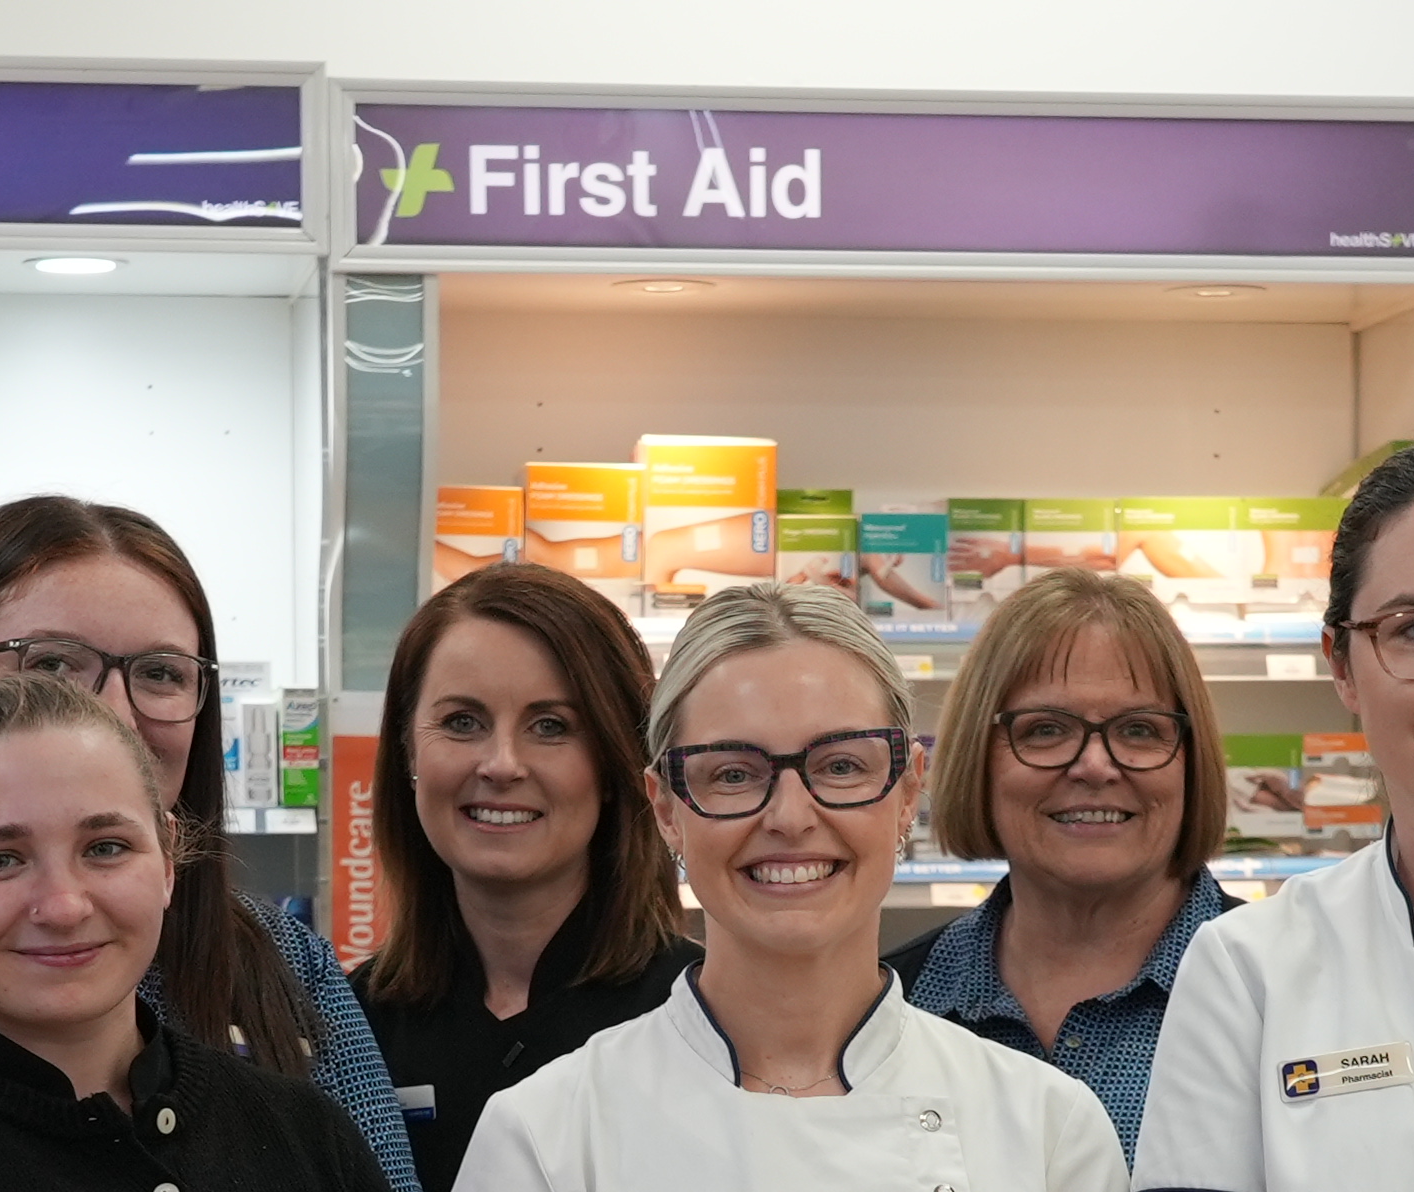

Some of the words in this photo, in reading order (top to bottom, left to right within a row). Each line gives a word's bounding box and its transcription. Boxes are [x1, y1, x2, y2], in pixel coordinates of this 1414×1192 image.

[469, 144, 658, 218] First
[682, 147, 822, 219] Aid
[1340, 1051, 1390, 1069] SARAH
[1341, 1068, 1394, 1085] Pharmacist
